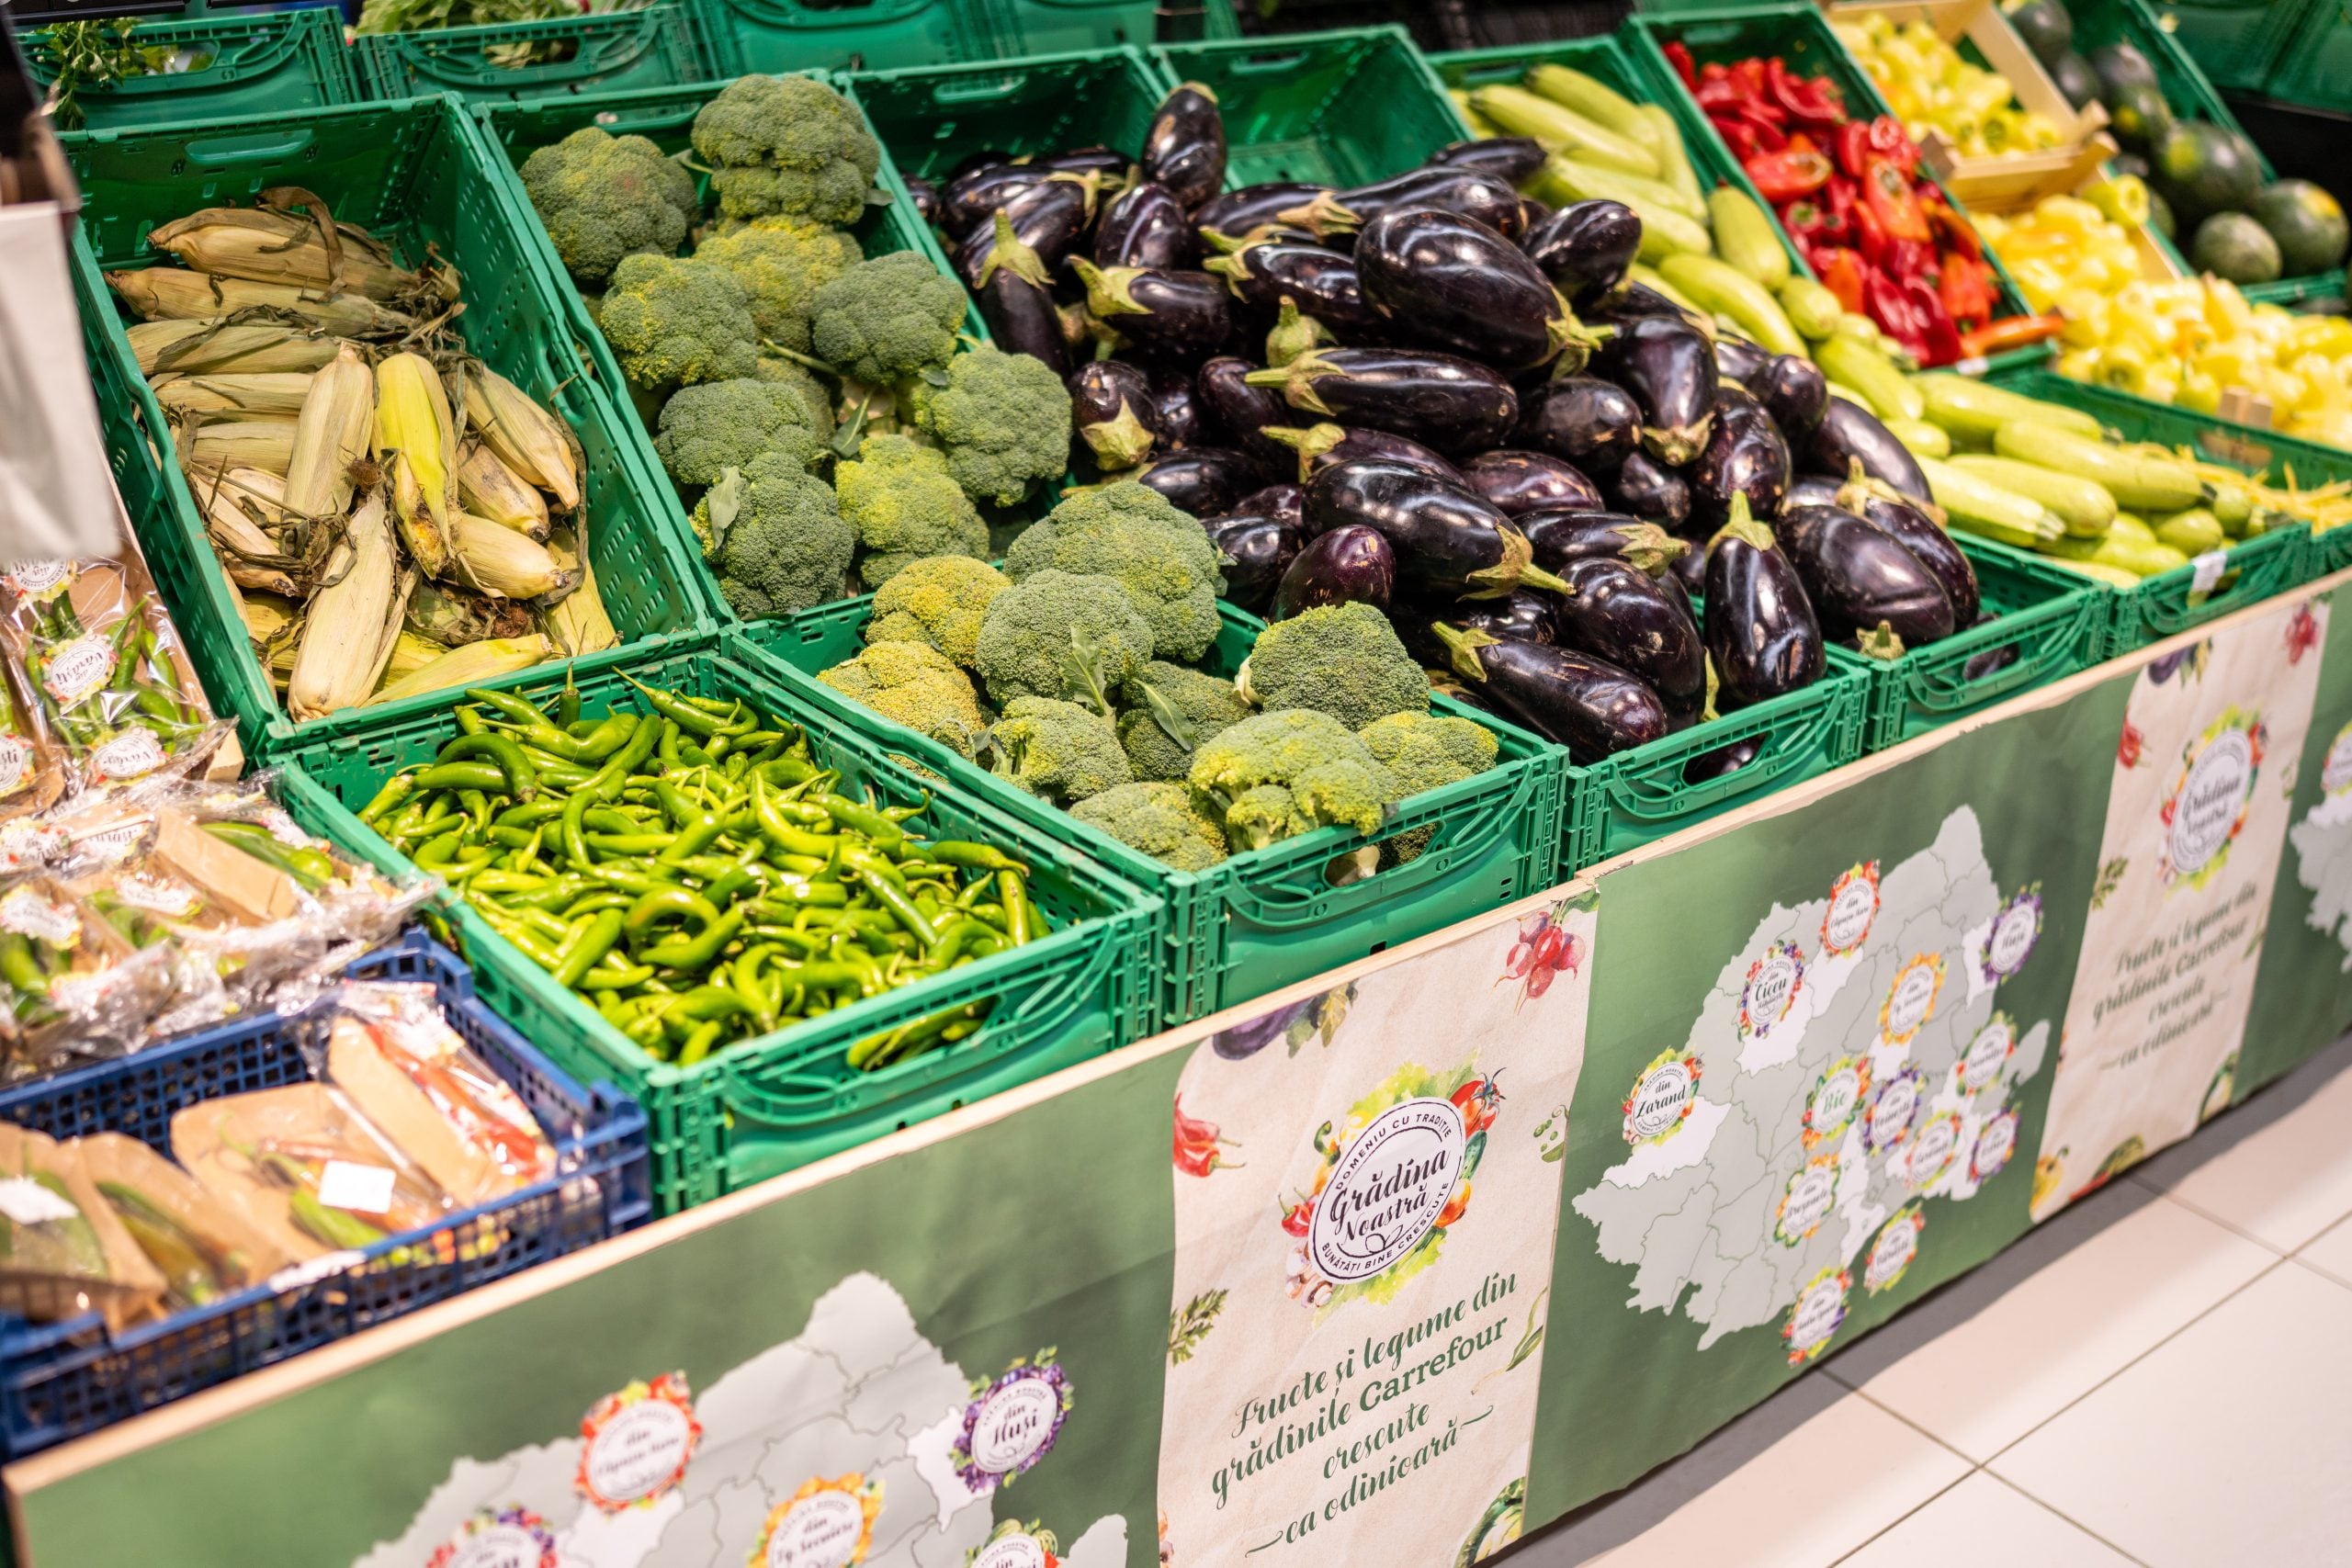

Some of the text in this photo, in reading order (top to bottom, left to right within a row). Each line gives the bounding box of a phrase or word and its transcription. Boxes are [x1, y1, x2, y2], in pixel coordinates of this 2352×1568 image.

[1635, 1084, 1686, 1119] Zarand
[1655, 1080, 1671, 1094] din
[1336, 1113, 1452, 1190] DOMENIU CU TRADIȚIE
[1330, 1150, 1451, 1235] Grădina
[1341, 1182, 1430, 1245] Noastră
[1364, 1249, 1393, 1269] BINE
[1397, 1182, 1449, 1249] CRESCUTE
[1231, 1271, 1518, 1438] Fructe și legume din
[1003, 1404, 1025, 1421] din
[1211, 1316, 1508, 1510] grădinile Carrefour
[1323, 1403, 1430, 1479] crescute
[1285, 1416, 1459, 1544] ca odinioară
